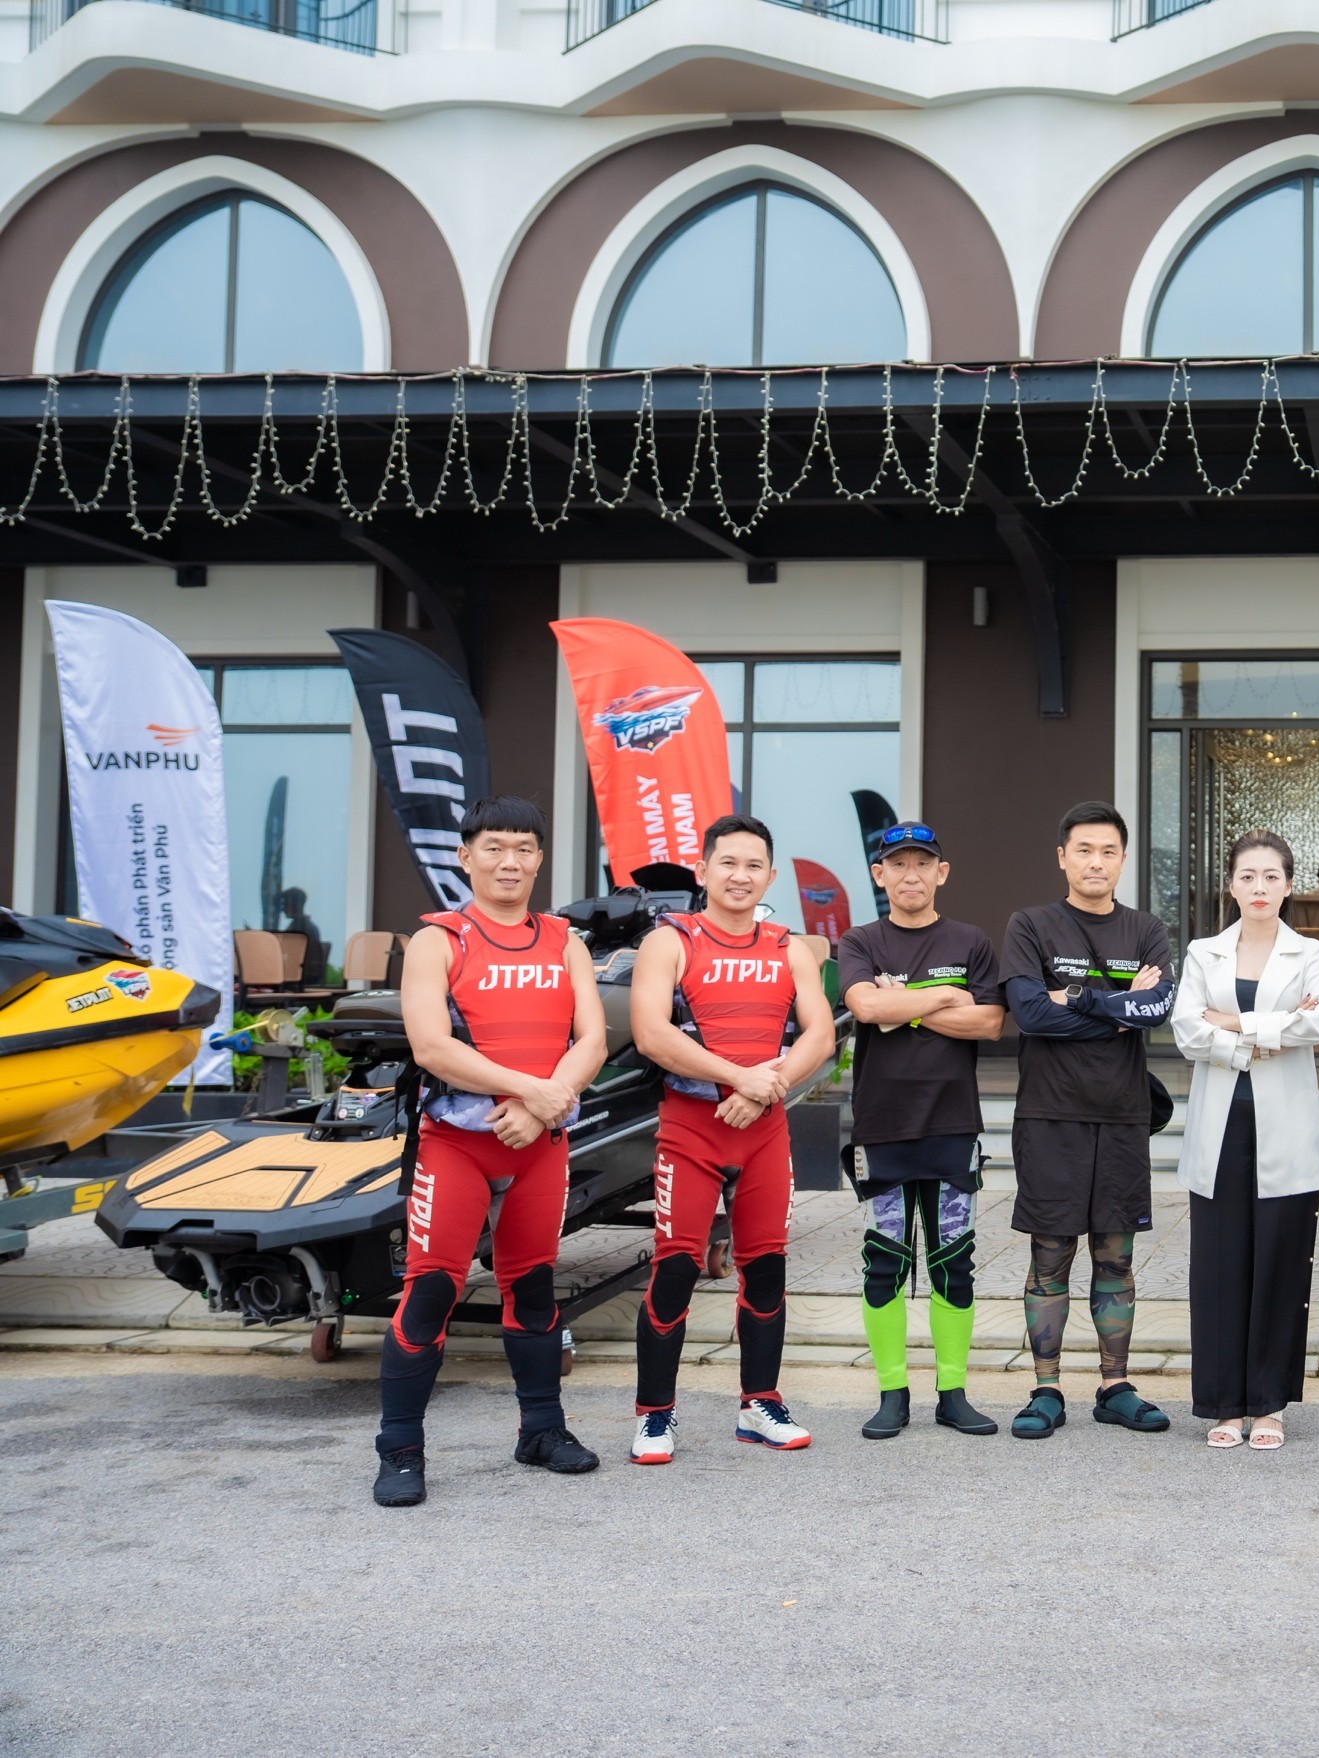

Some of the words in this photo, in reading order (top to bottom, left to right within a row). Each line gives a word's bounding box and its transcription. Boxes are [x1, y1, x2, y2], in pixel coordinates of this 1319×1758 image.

[616, 715, 683, 746] VSPF
[85, 751, 200, 772] VANPHU
[636, 775, 665, 832] MÁY
[671, 793, 700, 855] NAM
[703, 959, 783, 984] JTPLT
[1053, 957, 1089, 966] Kawasaki
[478, 965, 564, 990] JTPLT
[409, 1161, 435, 1253] JTPLT
[655, 1153, 674, 1239] JTPLT
